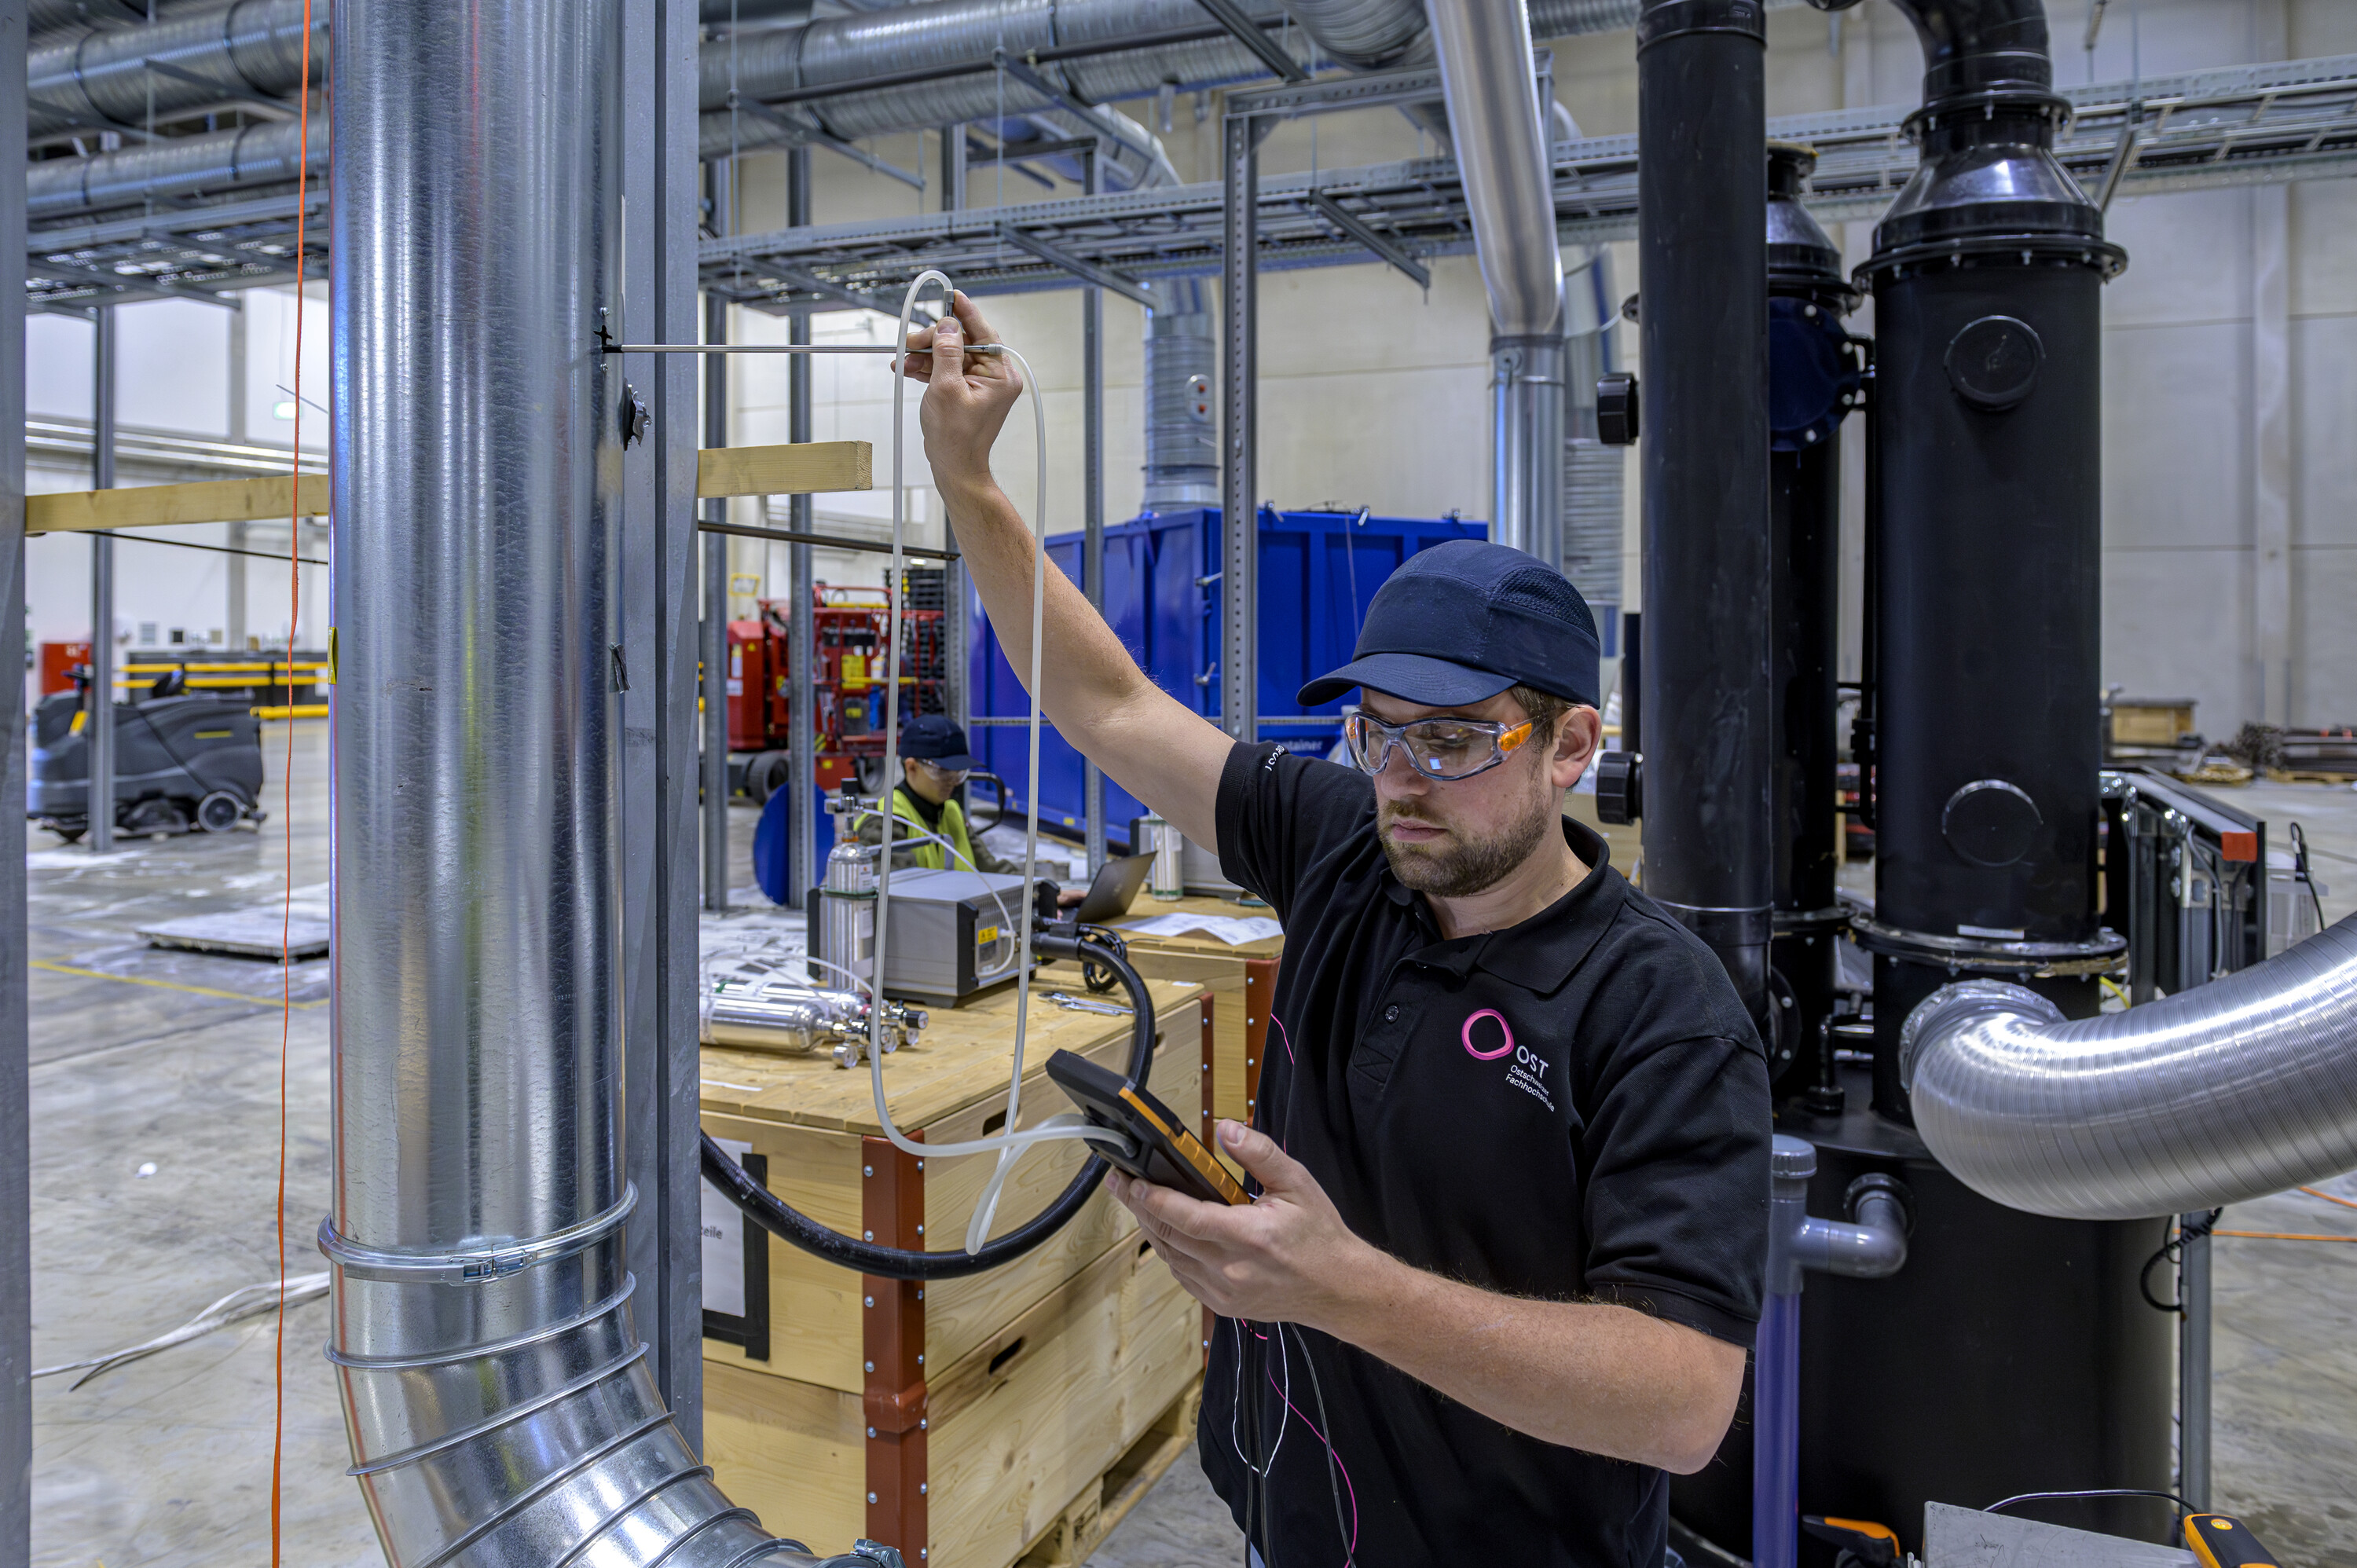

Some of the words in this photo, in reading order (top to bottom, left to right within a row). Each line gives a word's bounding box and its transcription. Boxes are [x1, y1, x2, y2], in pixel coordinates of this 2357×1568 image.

[1516, 1046, 1549, 1079] OST
[1505, 1073, 1555, 1112] Fachhochschule
[1510, 1064, 1549, 1096] Ostschweizer
